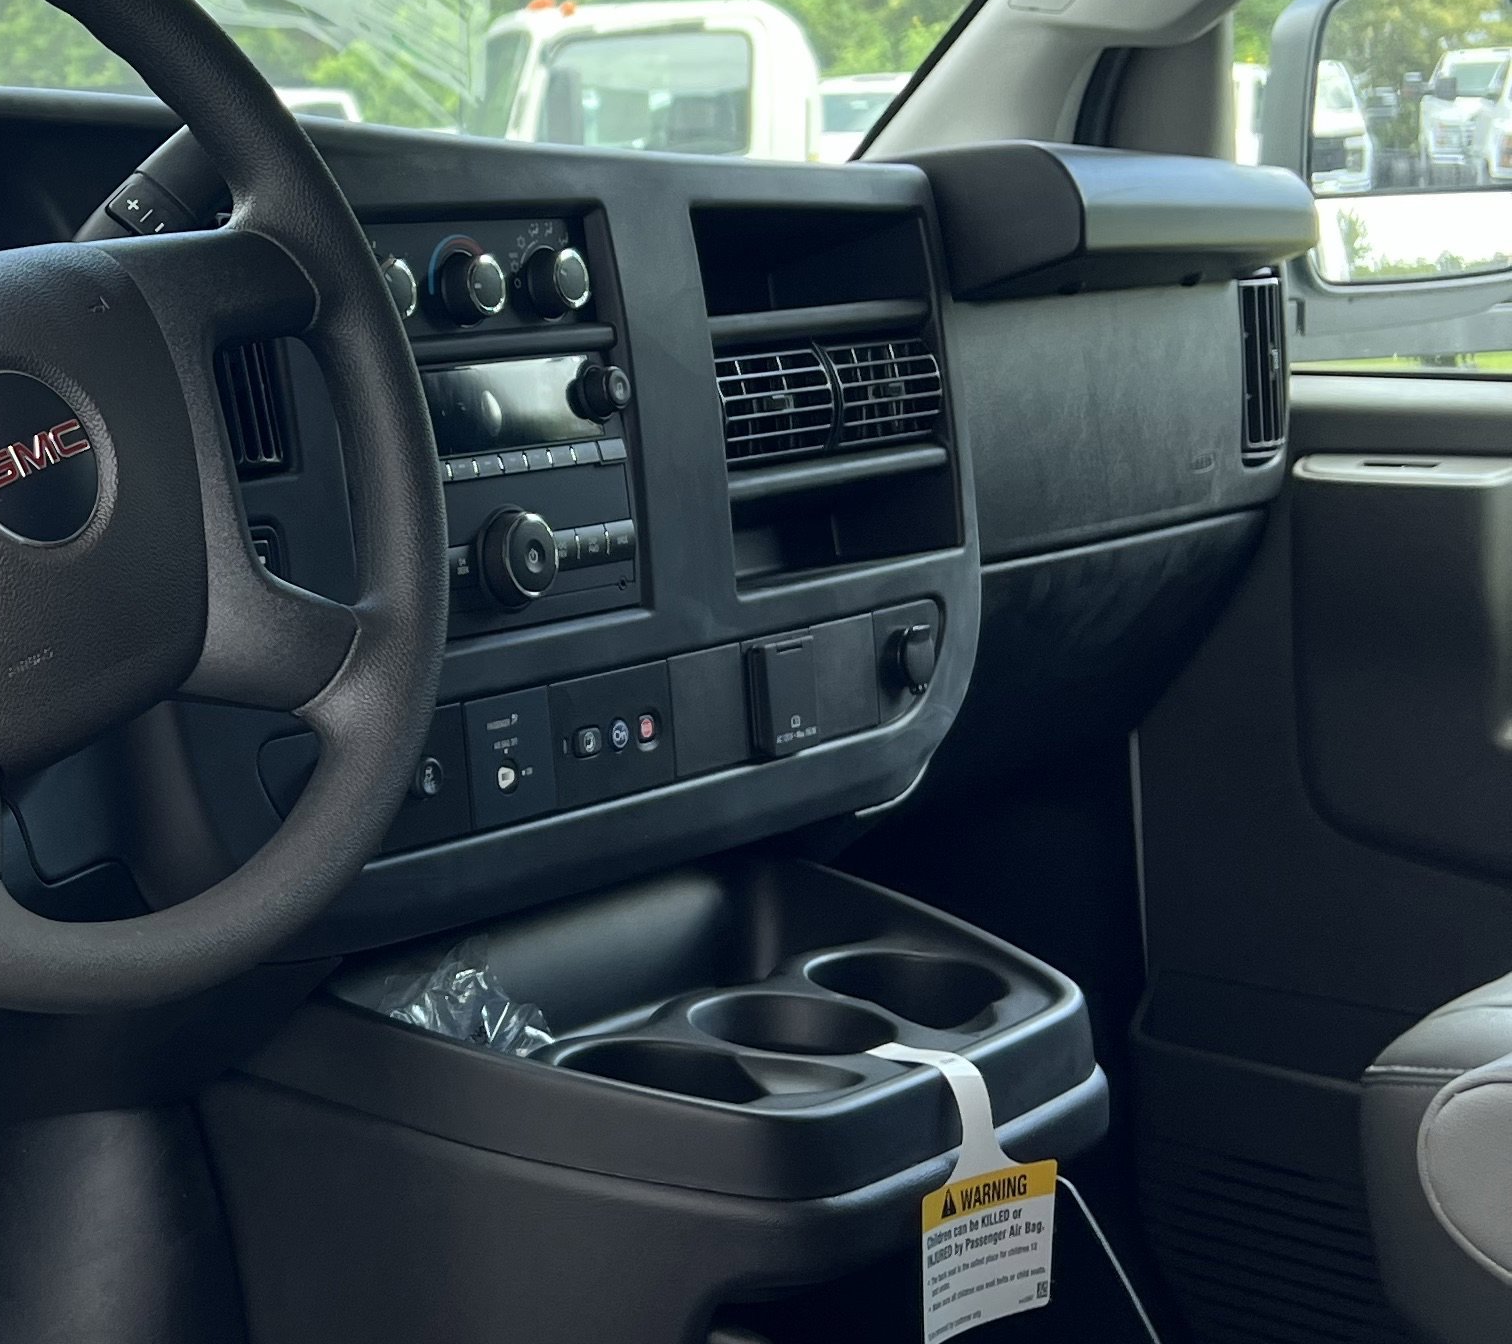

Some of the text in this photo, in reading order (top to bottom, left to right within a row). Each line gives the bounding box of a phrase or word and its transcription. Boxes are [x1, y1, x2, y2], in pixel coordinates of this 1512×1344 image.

[960, 1174, 1028, 1212] WARNING
[927, 1208, 1023, 1250] Children can be KILLED or
[927, 1221, 1045, 1269] INJURED by Passenger Air Bag.
